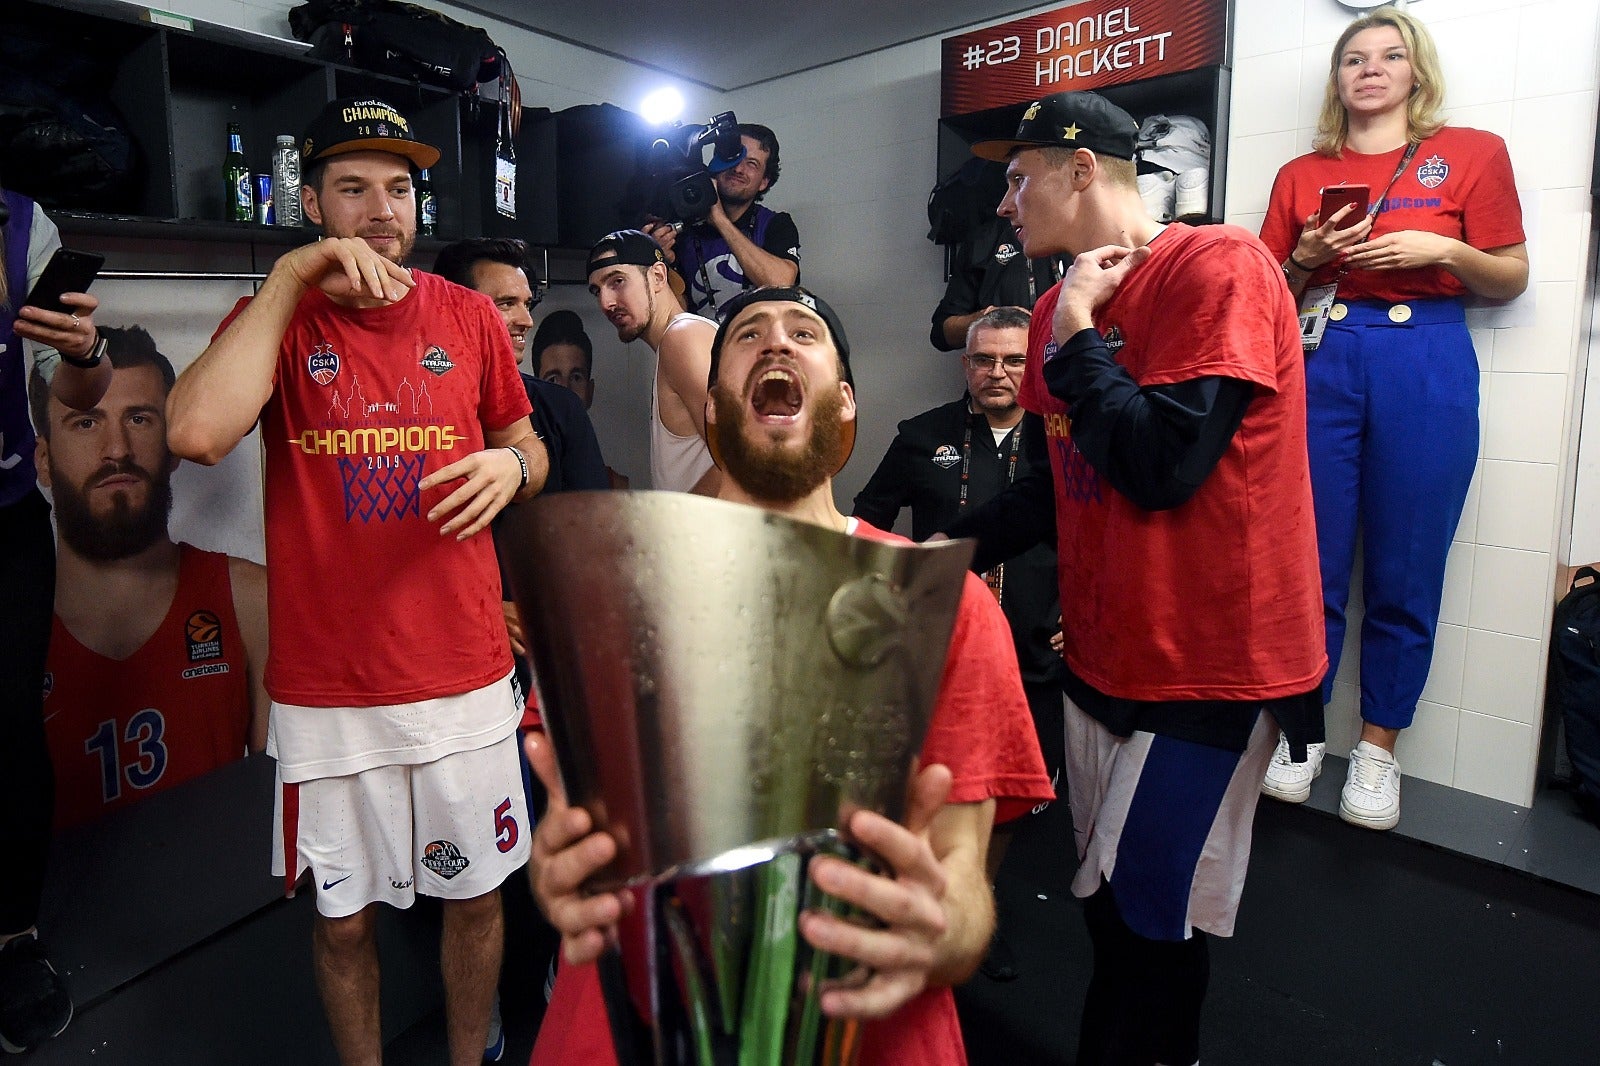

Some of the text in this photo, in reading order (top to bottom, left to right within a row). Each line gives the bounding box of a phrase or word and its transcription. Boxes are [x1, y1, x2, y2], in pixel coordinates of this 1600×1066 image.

[963, 7, 1139, 71] #23 DANIEL
[1036, 31, 1172, 86] HACKETT
[343, 107, 409, 133] CHAMPIONS
[312, 357, 336, 367] CSKA
[300, 425, 455, 454] CHAMPIONS
[367, 455, 400, 470] 2019
[191, 641, 219, 650] TURKISH
[191, 647, 220, 655] AIRLINES
[184, 664, 227, 677] oneteam
[85, 708, 168, 804] 13
[494, 797, 519, 853] 5
